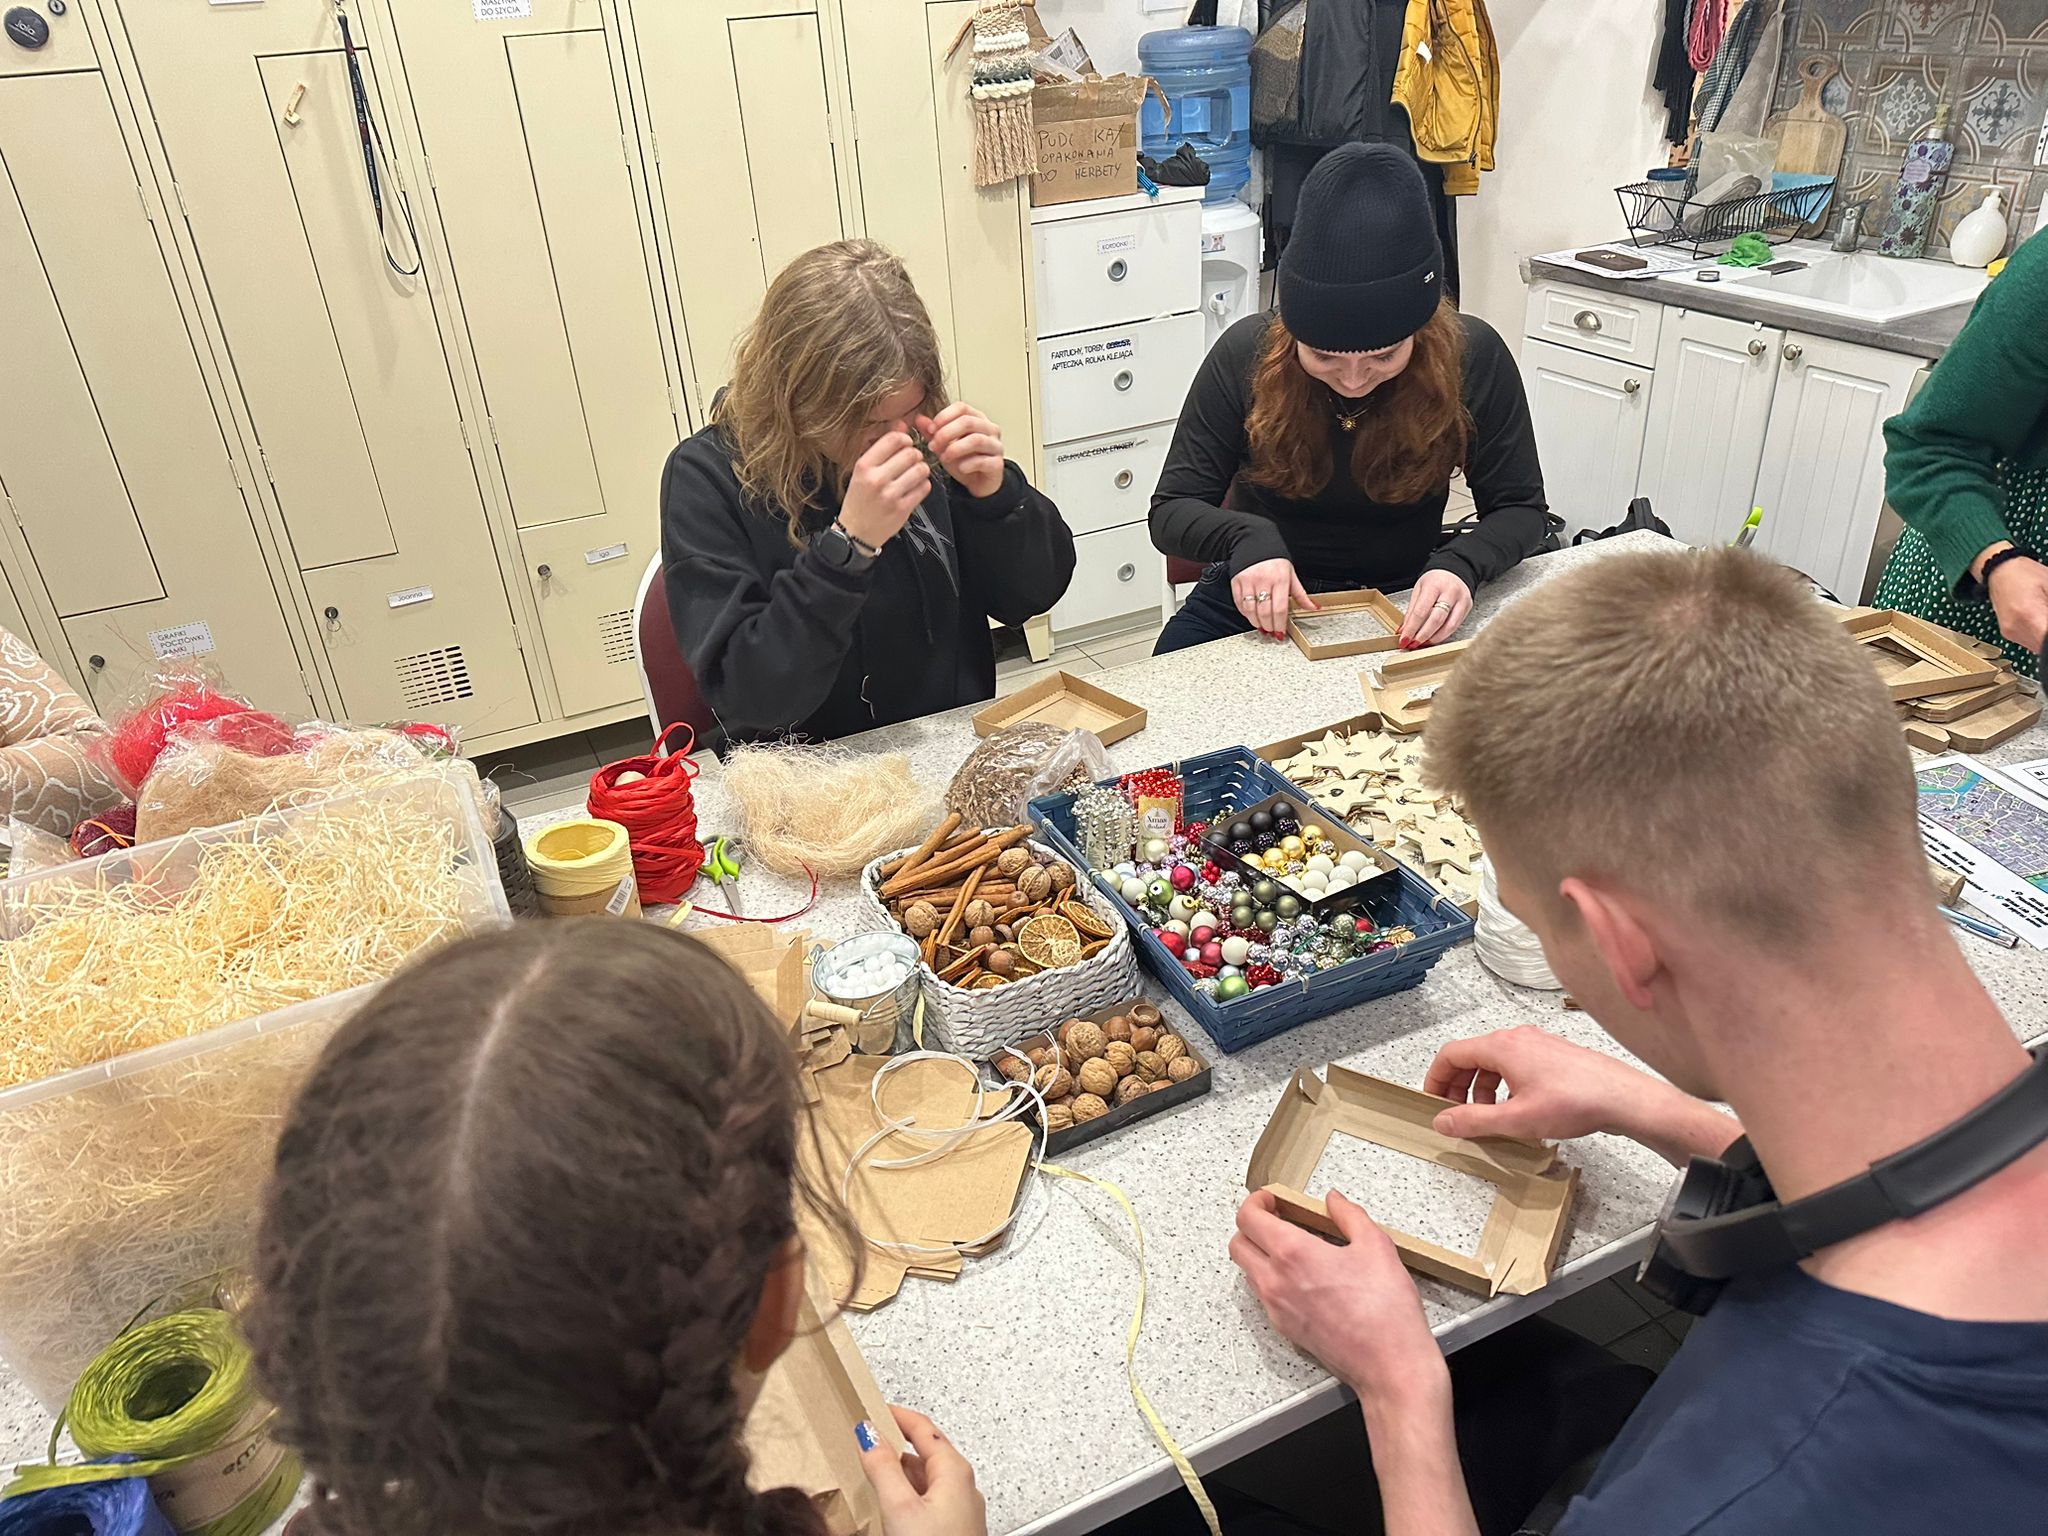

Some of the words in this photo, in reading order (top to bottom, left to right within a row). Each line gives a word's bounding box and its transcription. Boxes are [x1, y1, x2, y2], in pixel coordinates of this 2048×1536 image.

[481, 8, 494, 16] DO
[495, 6, 521, 15] SZYCIA
[157, 630, 187, 642] GRAFIKI
